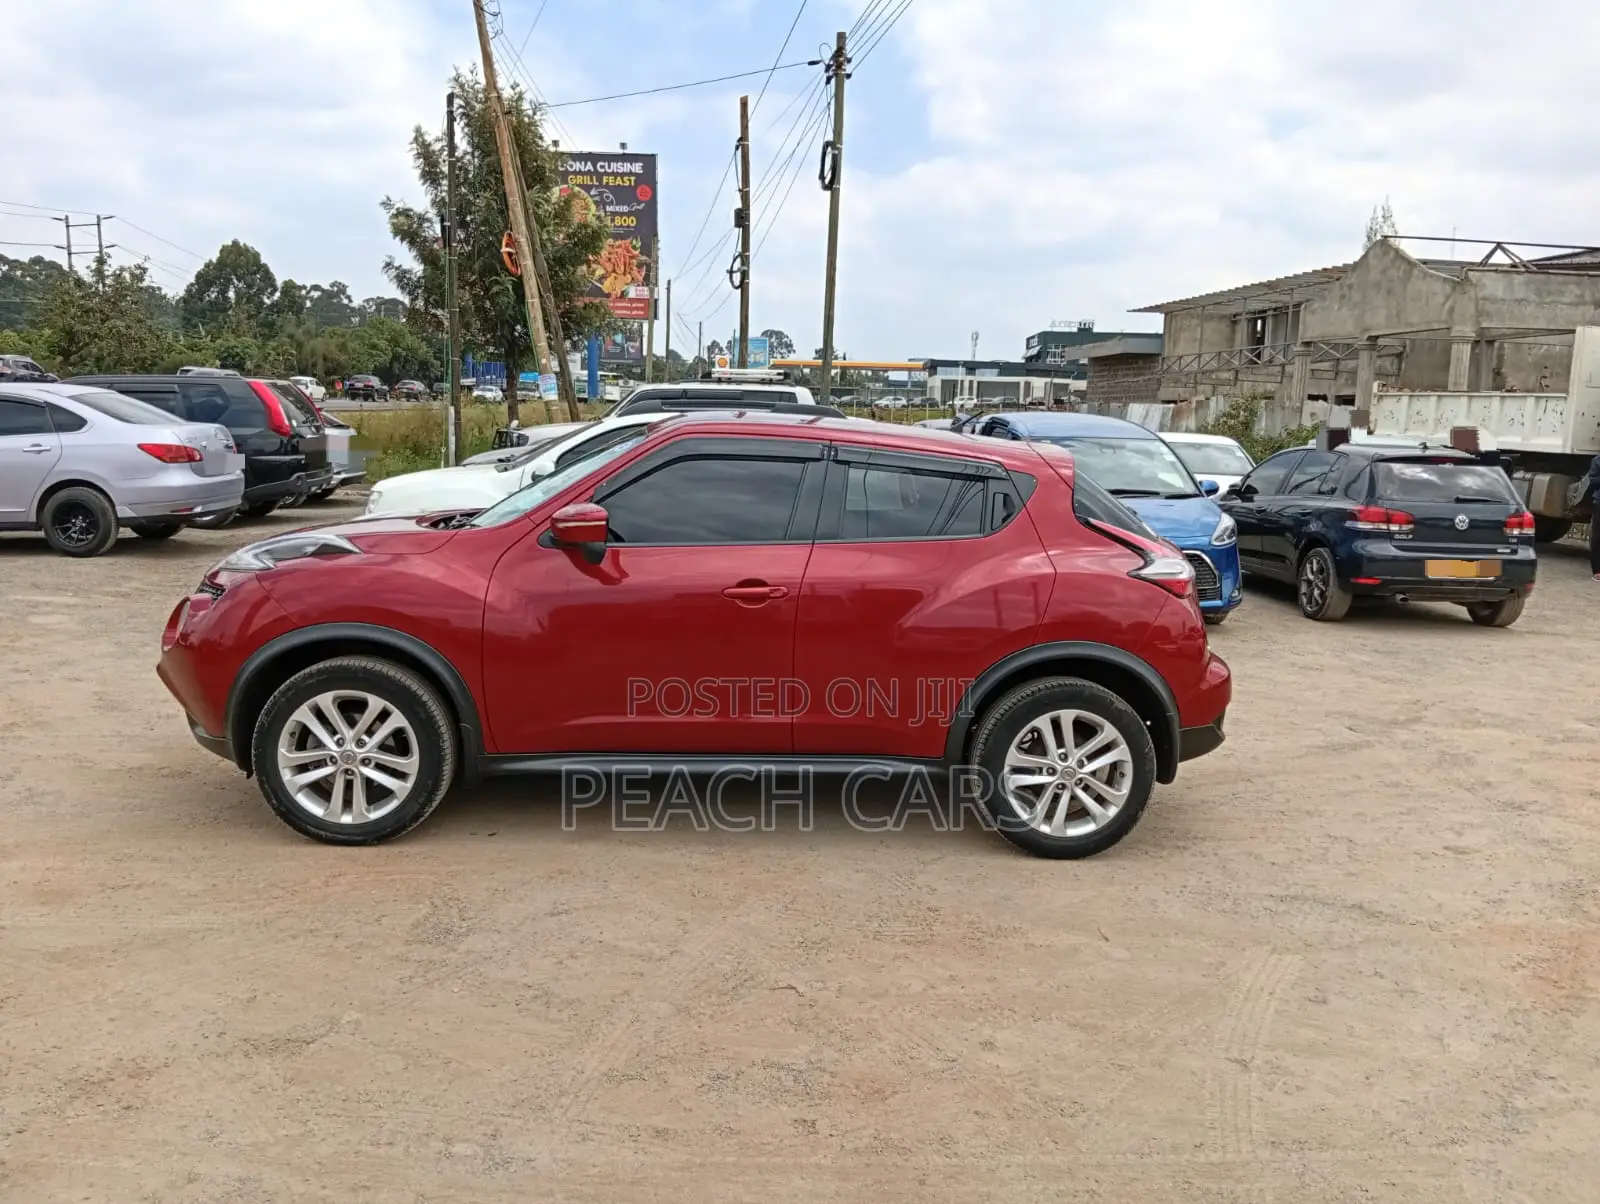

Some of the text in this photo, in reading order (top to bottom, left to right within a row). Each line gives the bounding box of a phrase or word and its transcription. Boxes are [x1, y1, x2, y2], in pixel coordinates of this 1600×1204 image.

[597, 162, 644, 173] CUISINE
[568, 175, 636, 187] GRILL FEAST
[606, 204, 629, 213] MIXED
